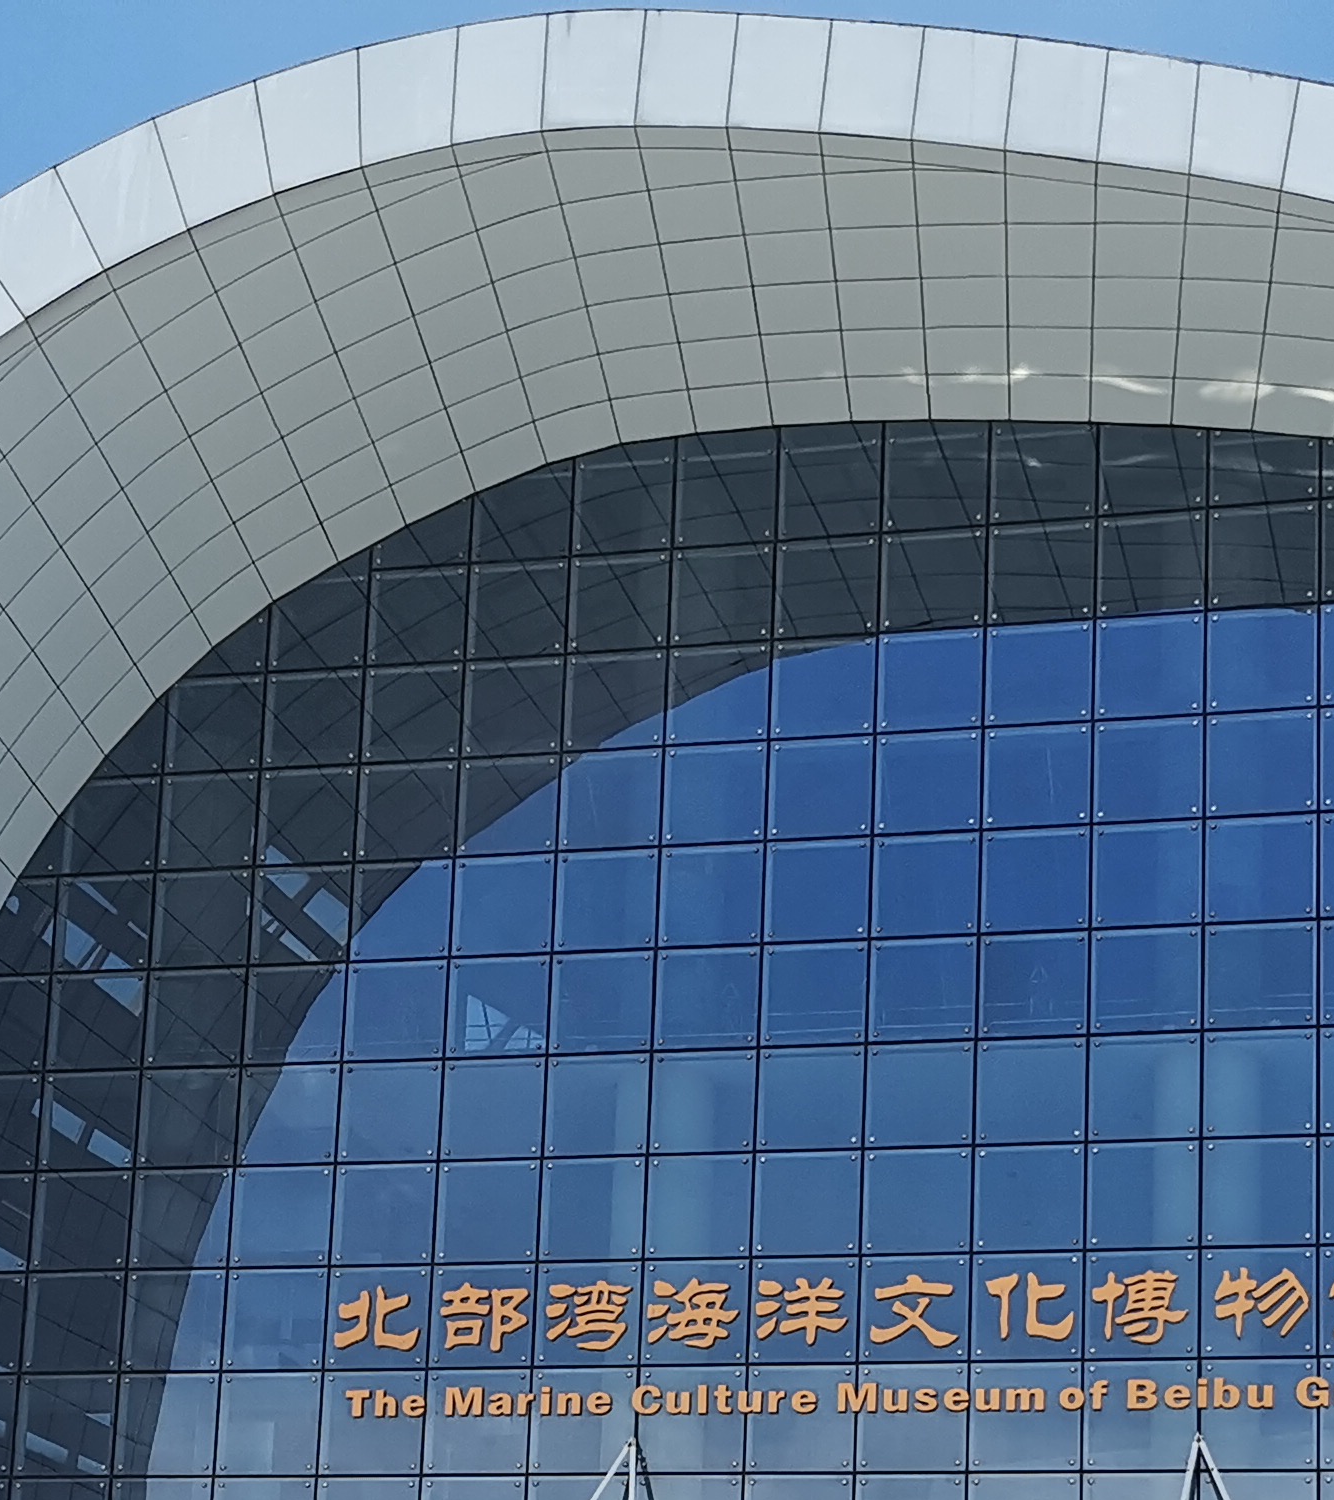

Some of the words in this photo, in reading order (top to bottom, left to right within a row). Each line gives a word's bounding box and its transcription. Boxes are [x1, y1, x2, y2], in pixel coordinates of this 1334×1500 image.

[345, 1389, 426, 1417] The
[444, 1386, 612, 1416] Marine
[631, 1383, 818, 1414] Culture
[836, 1380, 1045, 1413] Museum
[1059, 1379, 1108, 1411] of
[1126, 1377, 1274, 1410] Beibu
